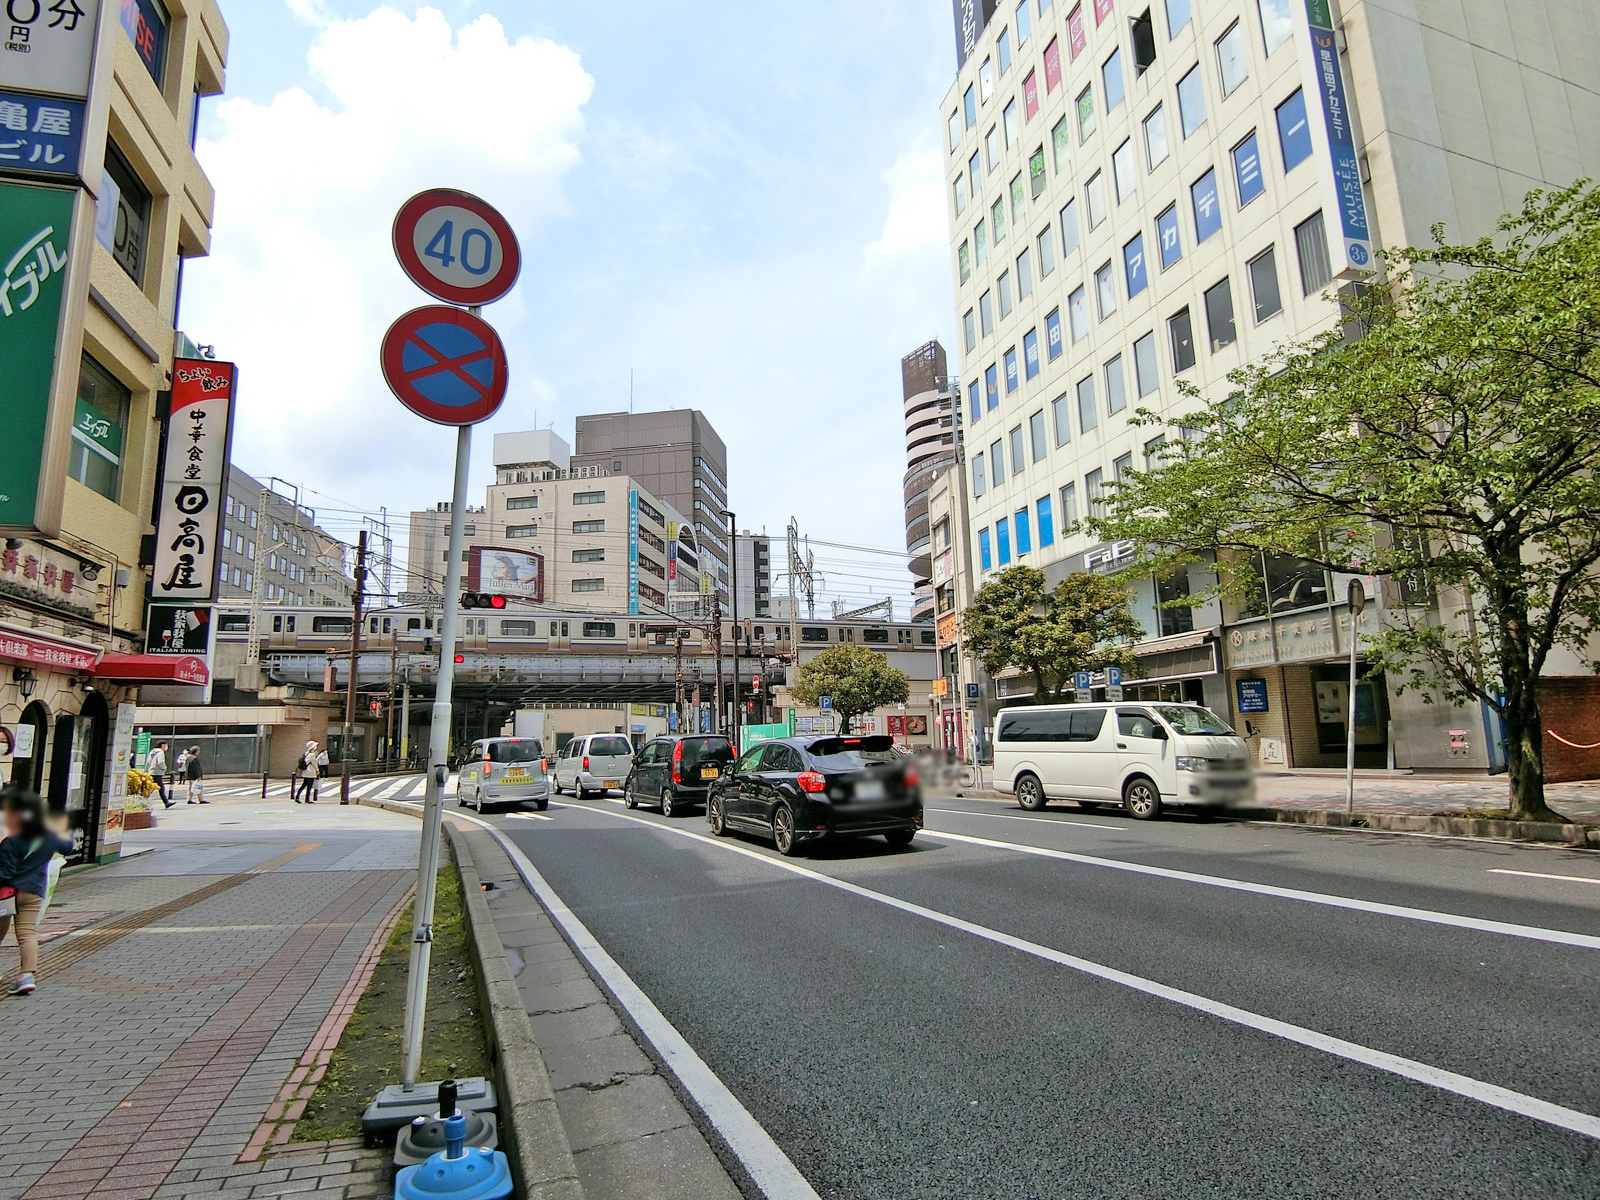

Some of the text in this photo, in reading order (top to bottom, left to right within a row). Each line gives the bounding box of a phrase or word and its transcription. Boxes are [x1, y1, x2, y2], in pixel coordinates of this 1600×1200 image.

[10, 26, 29, 42] 円
[1321, 49, 1342, 139] 早稲田アカデミー
[0, 101, 71, 136] 亀屋
[1349, 159, 1366, 229] PLATINUM
[424, 220, 493, 275] 40
[1350, 246, 1367, 262] 3F
[176, 367, 212, 383] ちょい
[201, 376, 229, 392] 飲み
[79, 412, 111, 438] エイブル
[184, 408, 207, 480] 中華食堂
[161, 485, 209, 591] 日高屋
[489, 579, 512, 593] Julien
[1079, 674, 1087, 688] P
[1111, 670, 1118, 684] P
[970, 685, 977, 696] P
[823, 698, 830, 707] P
